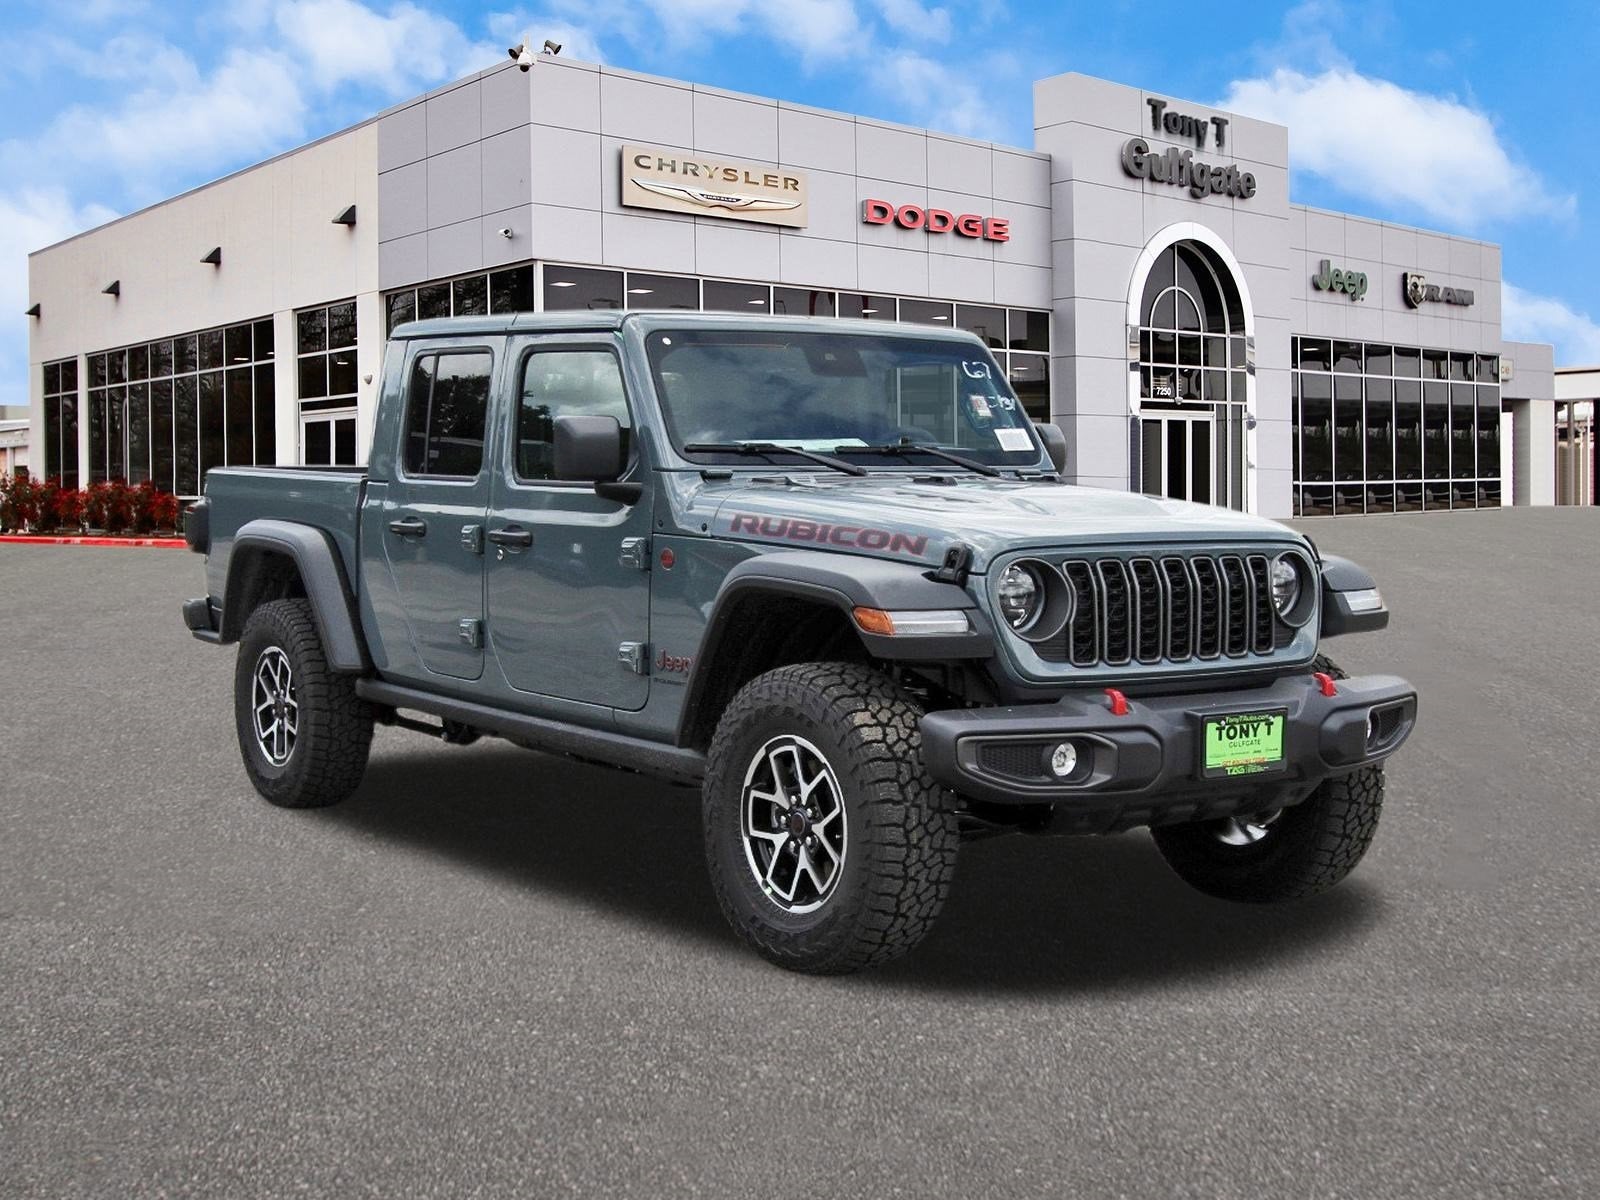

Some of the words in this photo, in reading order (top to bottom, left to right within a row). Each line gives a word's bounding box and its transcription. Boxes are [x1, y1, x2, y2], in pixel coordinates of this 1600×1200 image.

[1147, 98, 1208, 148] Tony
[1211, 116, 1229, 147] T
[633, 153, 800, 192] CHRYSLER
[1121, 137, 1256, 199] Gulfgate
[863, 198, 1011, 242] DODGE
[1312, 259, 1368, 301] Jeep
[1424, 284, 1475, 307] RAM
[1156, 387, 1172, 396] 7250
[729, 512, 930, 557] RUBICON
[1216, 722, 1260, 741] TONY
[1264, 721, 1274, 736] T
